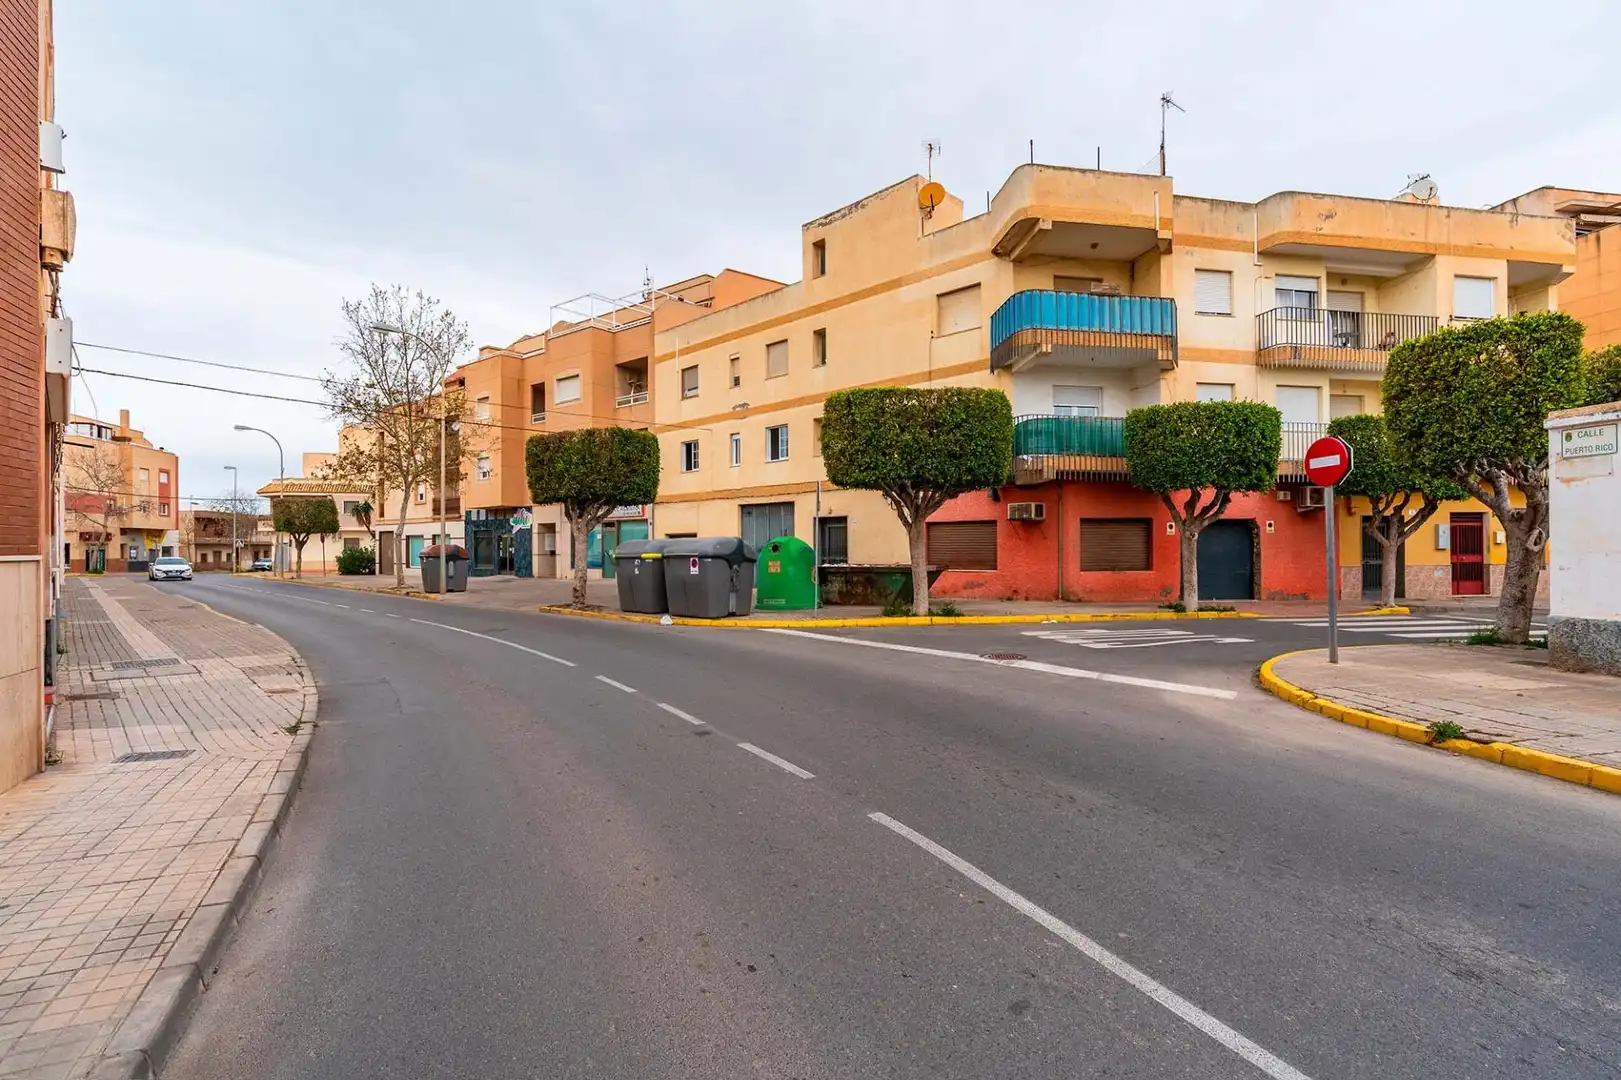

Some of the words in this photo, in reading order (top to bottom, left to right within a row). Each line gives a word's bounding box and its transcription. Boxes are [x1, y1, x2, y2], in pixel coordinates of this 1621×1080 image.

[1577, 428, 1604, 439] CALLE
[1565, 445, 1594, 455] PUERTO
[1595, 443, 1614, 452] RICO
[1019, 628, 1256, 649] STOP
